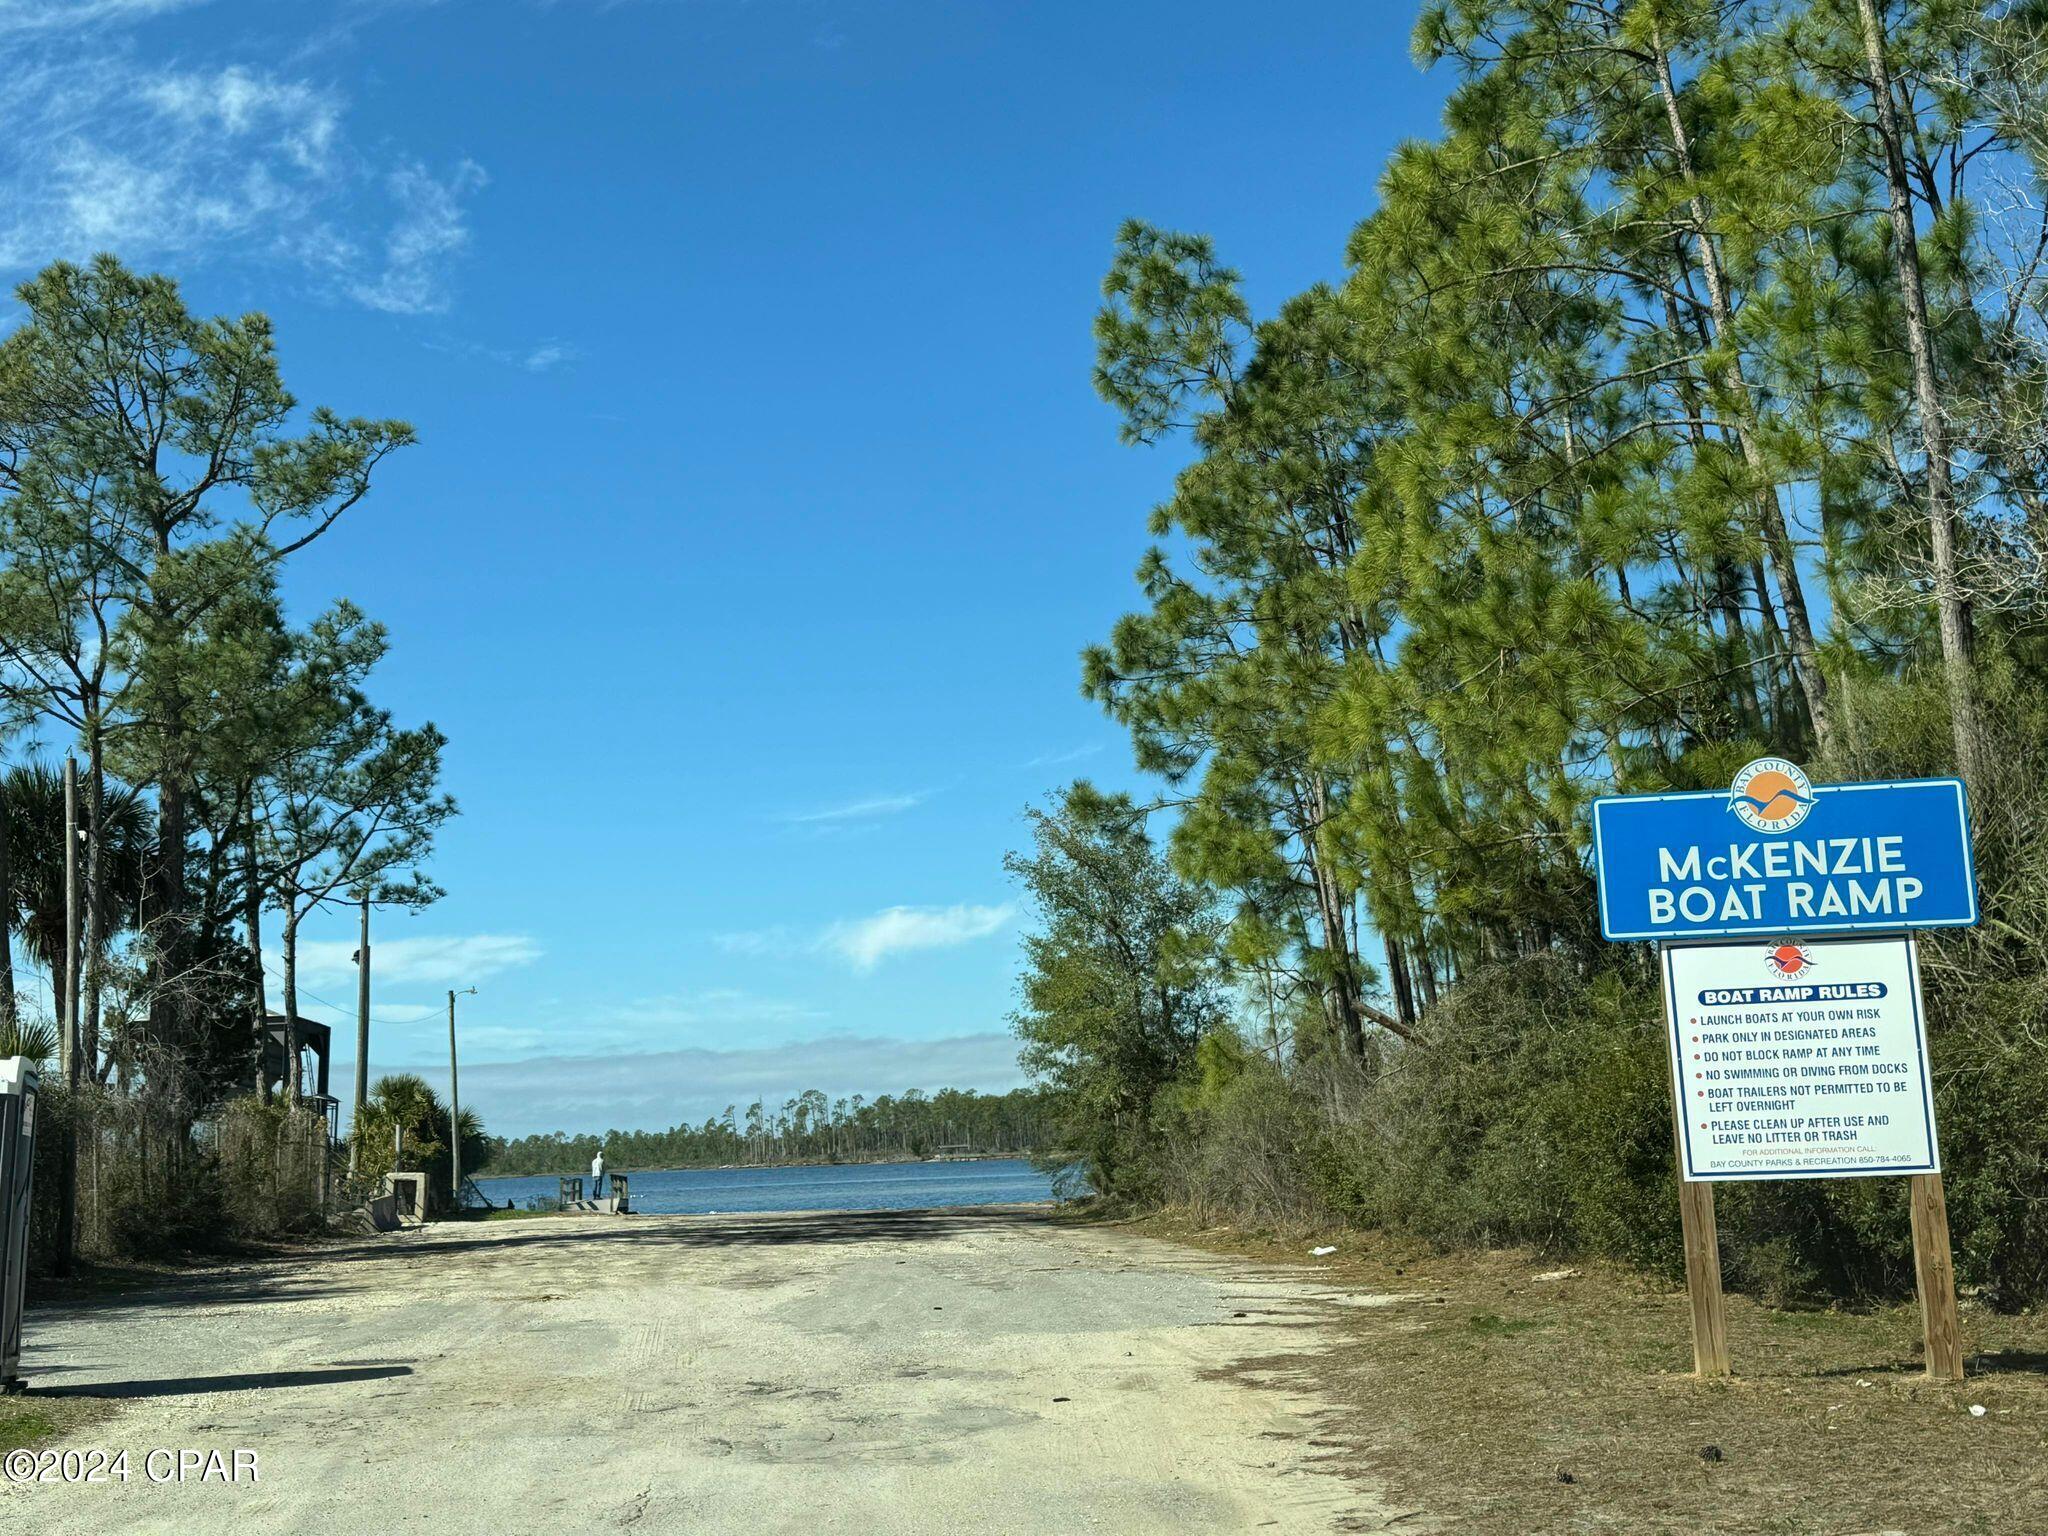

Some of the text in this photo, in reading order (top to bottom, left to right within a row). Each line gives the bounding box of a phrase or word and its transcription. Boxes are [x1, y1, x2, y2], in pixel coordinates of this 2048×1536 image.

[1736, 762, 1806, 793] BAY COUNTY
[1739, 804, 1807, 829] FLORIDA
[1658, 836, 1906, 882] McKENZIE
[1648, 877, 1923, 924] BOAT RAMP
[1704, 985, 1881, 1004] BOAT RAMP RULES
[1700, 1009, 1880, 1025] LAUNCH BOATS AT YOUR OWN RISK
[1703, 1028, 1876, 1043] PARK ONLY IN DESIGNATED AREAS
[1704, 1042, 1880, 1061] DO NOT BLOCK RAMP AT ANY TIME
[1706, 1063, 1908, 1080] NO SWIMMING OR DIVING FROM DOCKS
[1708, 1081, 1907, 1098] BOAT TRAILERS NOT PERMITTED TO BE
[1709, 1100, 1795, 1112] LEFT OVERNIGHT
[1711, 1115, 1889, 1131] PLEASE CLEAN UP AFTER USE AND
[1713, 1130, 1857, 1145] LEAVE NO LITTER OR TRASH
[1805, 1146, 1855, 1154] INFORMATION
[1711, 1160, 1726, 1168] BAY
[1728, 1159, 1764, 1168] COUNTY
[1766, 1158, 1793, 1166] PARKS
[1803, 1157, 1857, 1165] RECREATION
[1859, 1155, 1911, 1164] 850-784-4065
